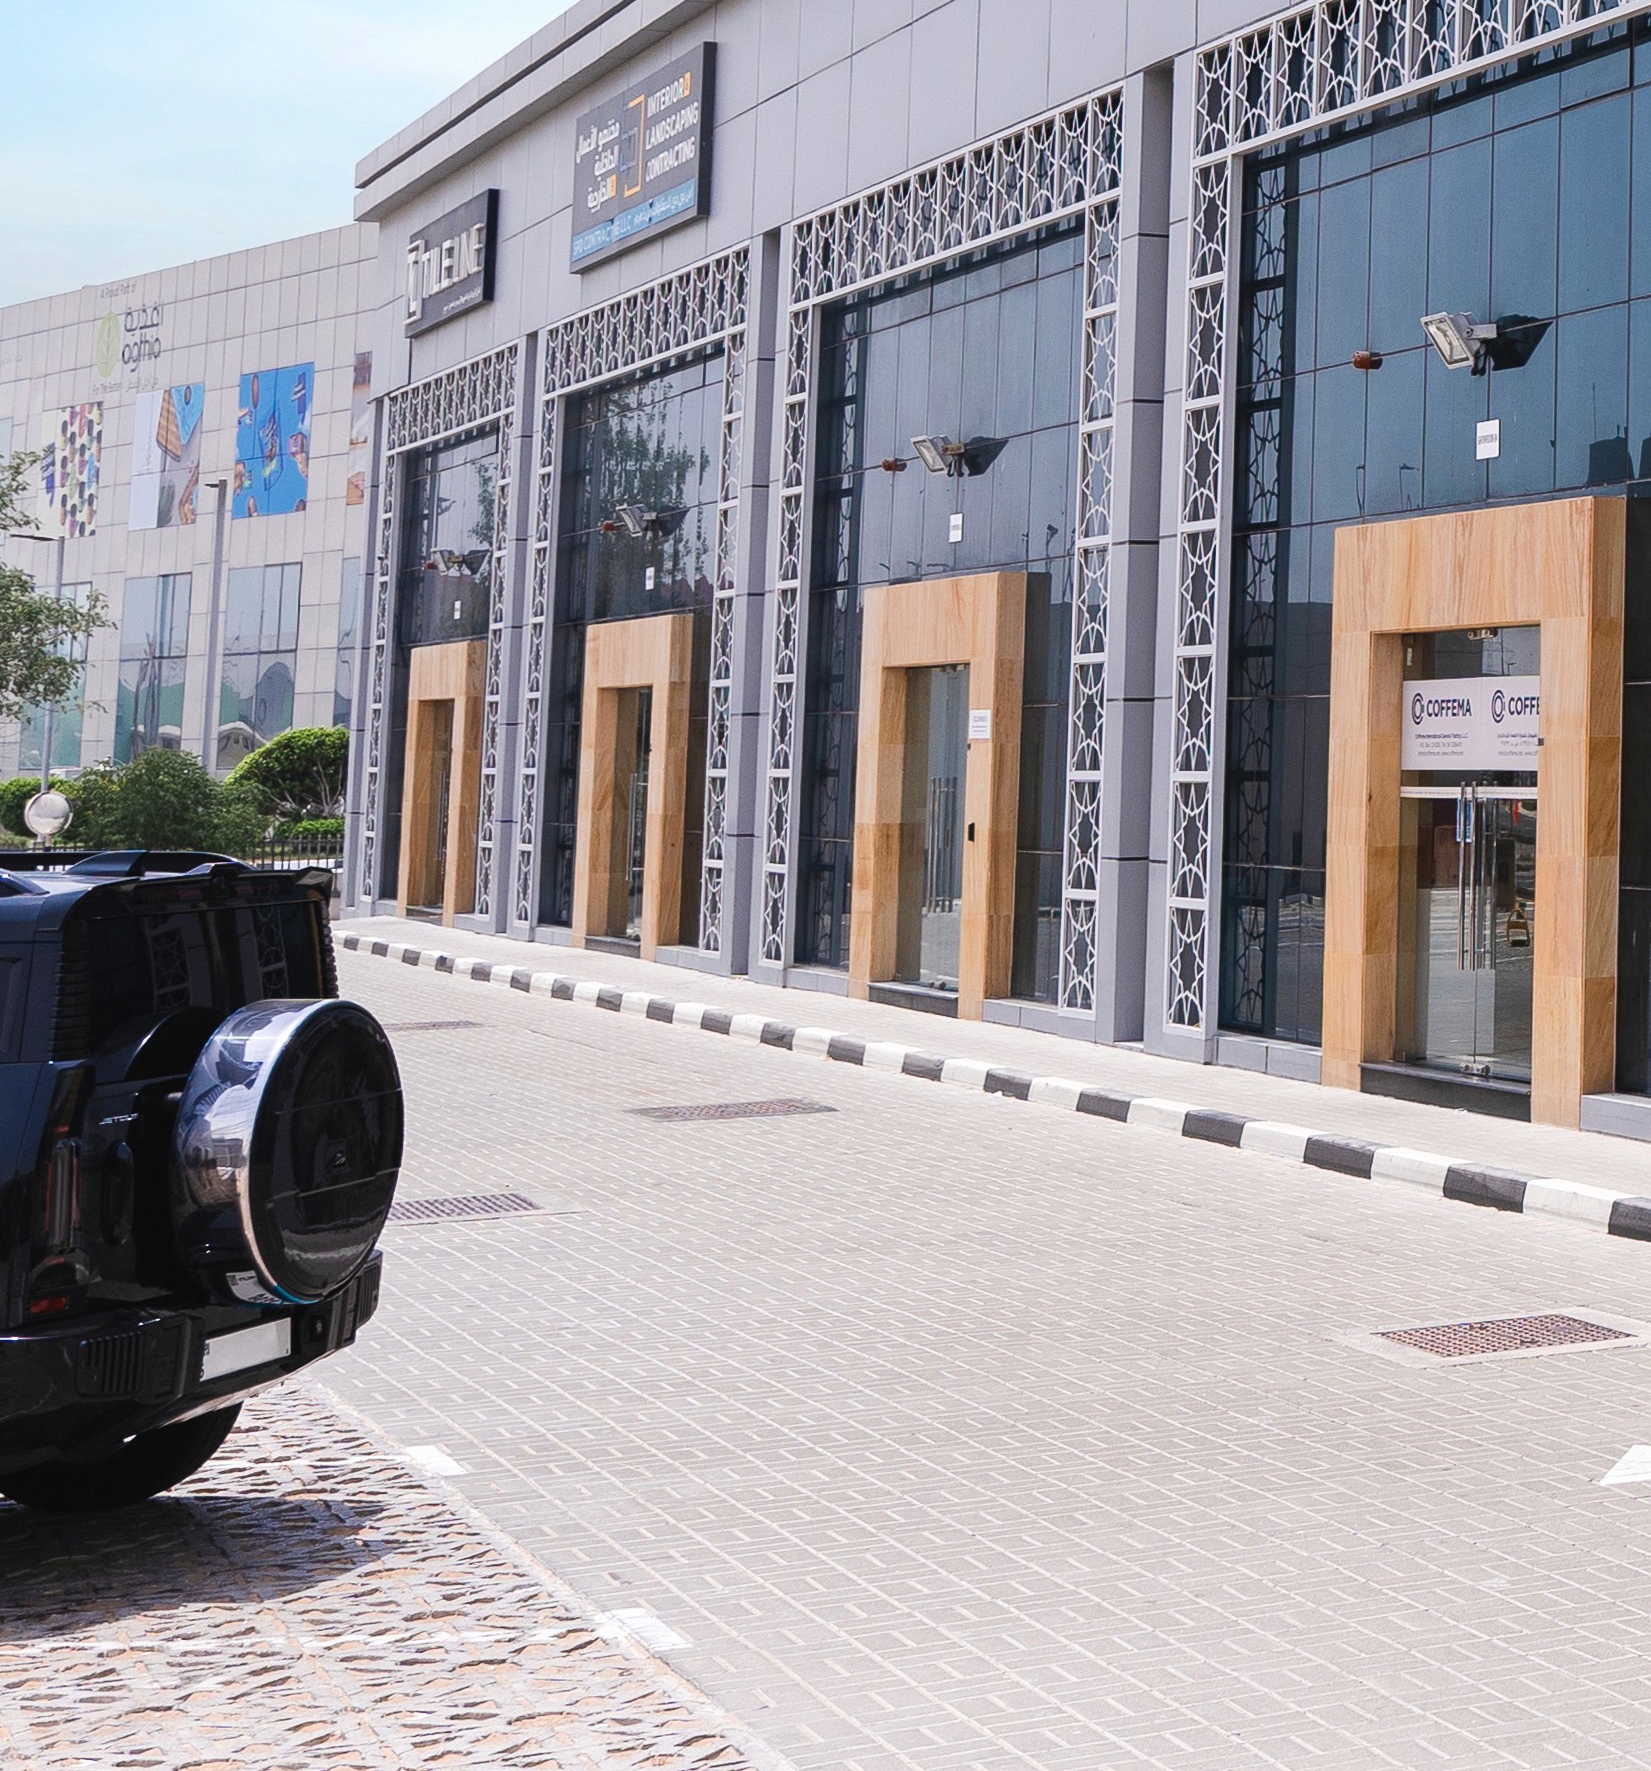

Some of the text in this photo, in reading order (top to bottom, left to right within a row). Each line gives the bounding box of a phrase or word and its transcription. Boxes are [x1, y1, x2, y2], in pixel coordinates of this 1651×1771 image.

[646, 77, 684, 118] INTERIOR
[645, 100, 699, 150] LANDSCAPING
[645, 136, 696, 182] CONTRACTING
[1426, 698, 1472, 719] COFFEMA
